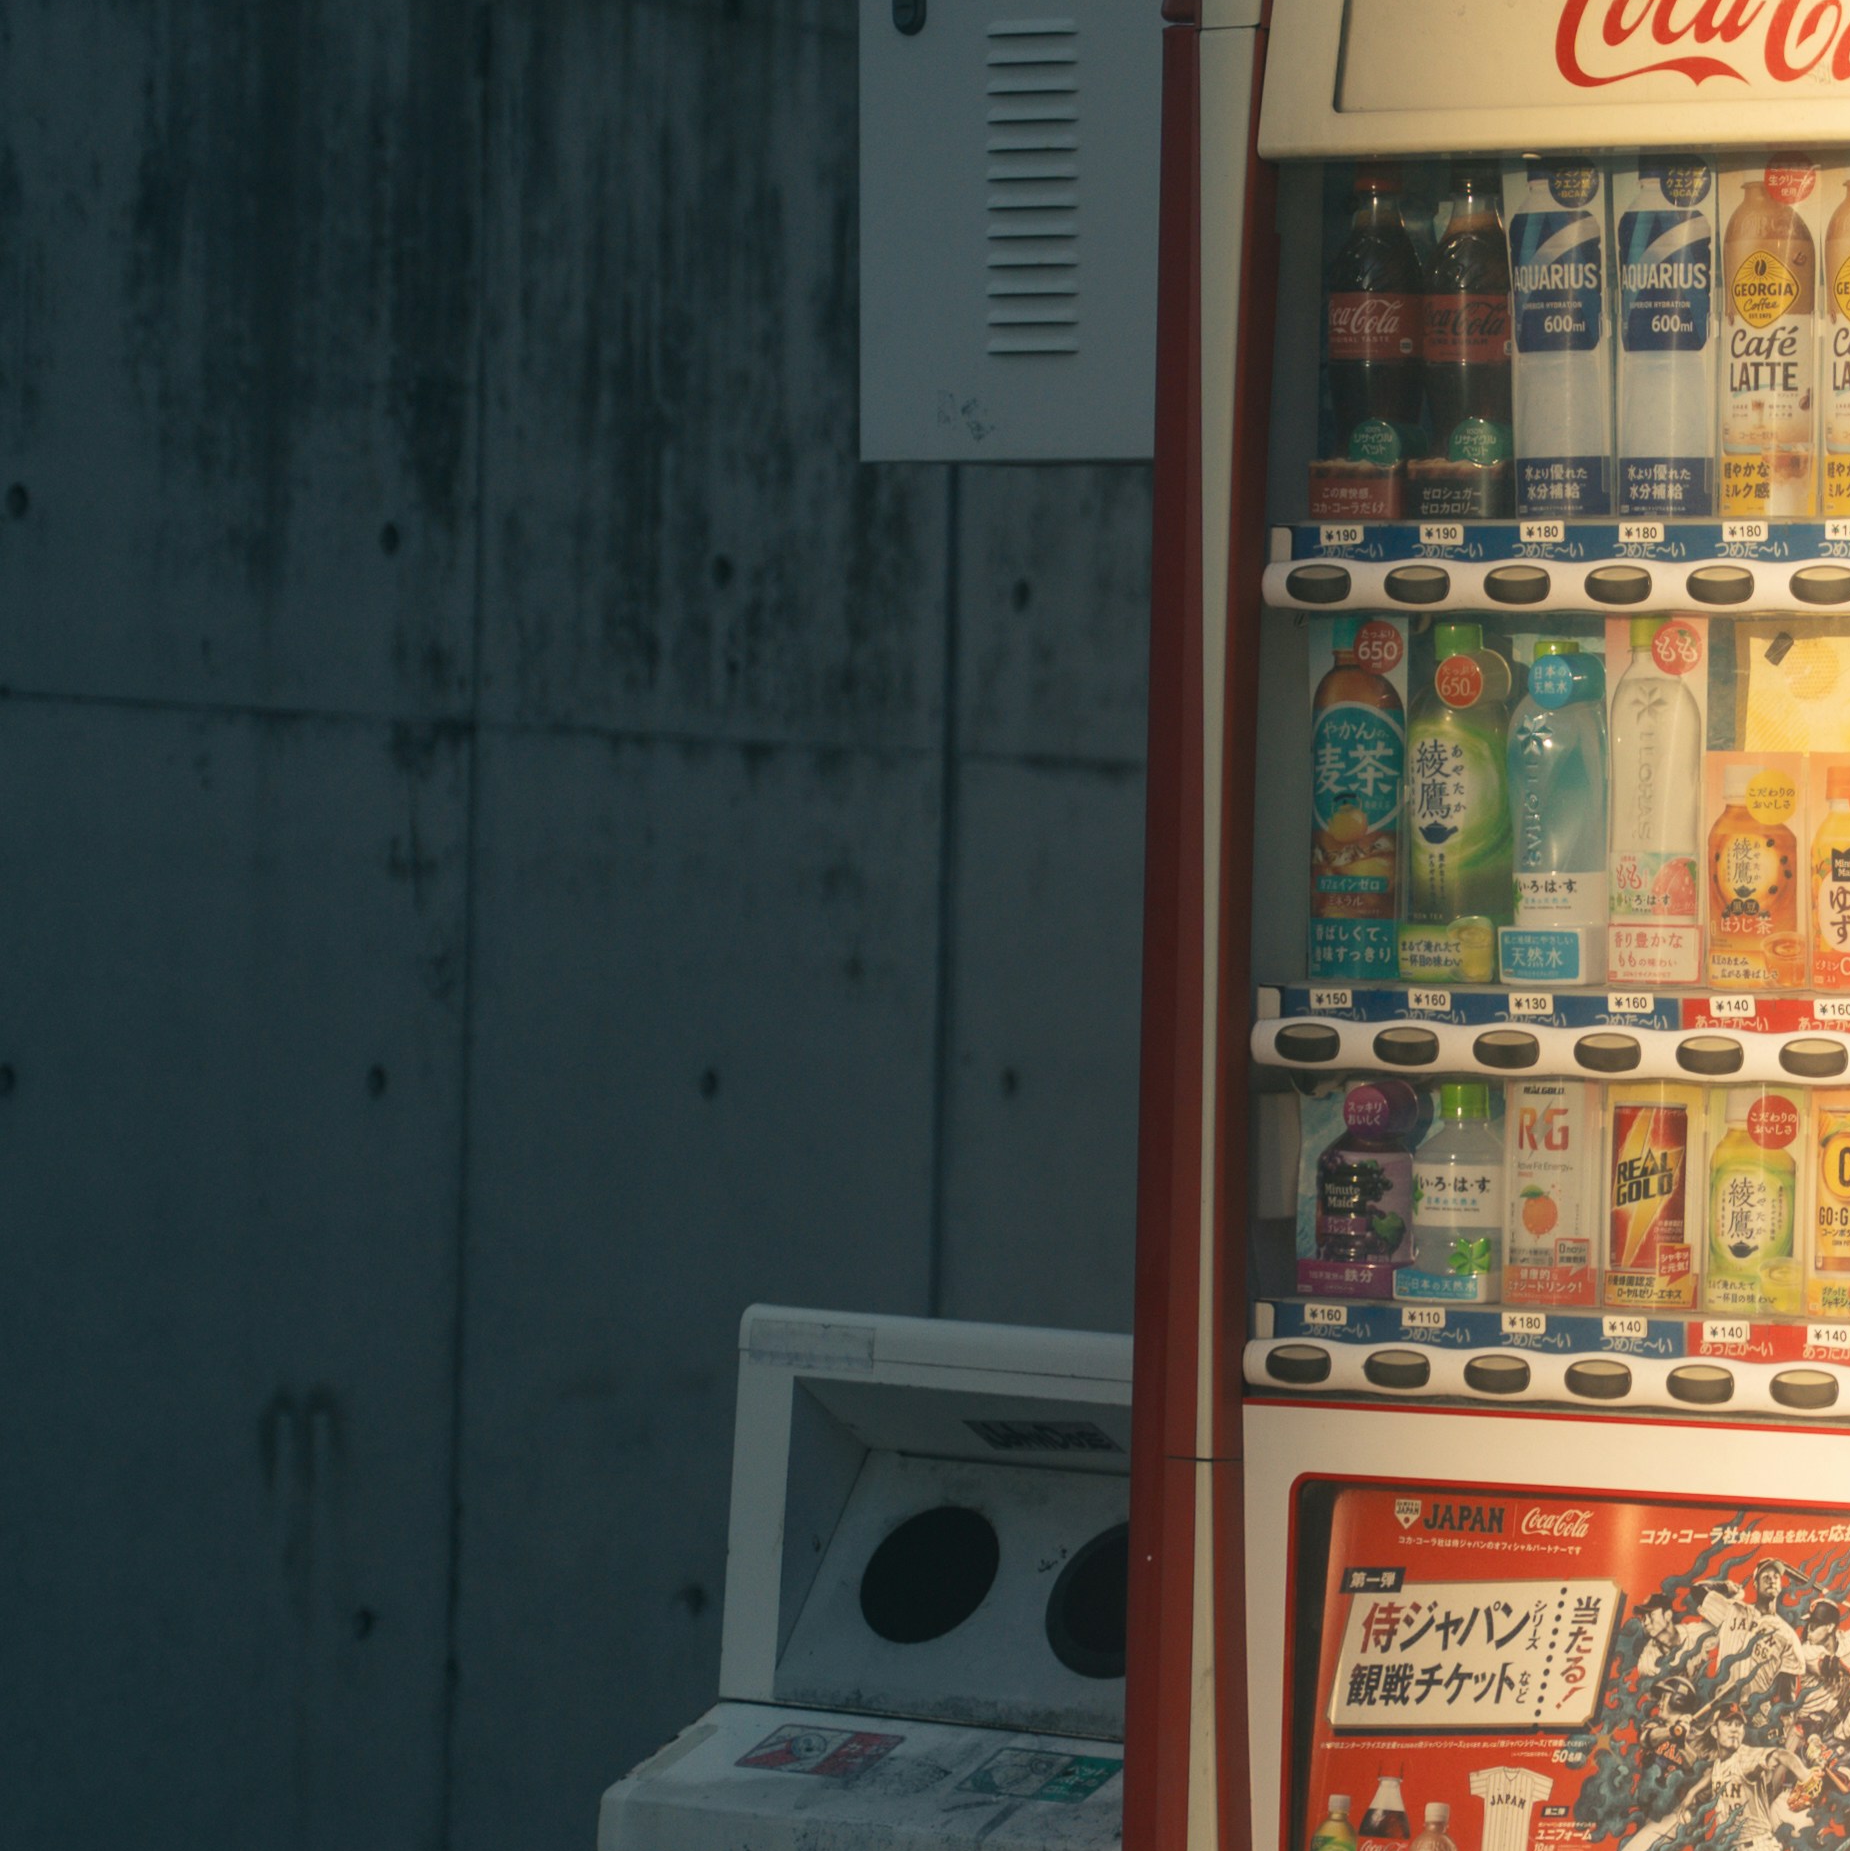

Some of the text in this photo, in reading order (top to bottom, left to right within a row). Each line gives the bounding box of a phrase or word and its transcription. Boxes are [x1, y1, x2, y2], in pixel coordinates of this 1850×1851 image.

[1514, 264, 1598, 290] AQUARIUS
[1621, 264, 1708, 290] AQUARIUS
[1734, 282, 1795, 298] GEORGIA
[1544, 315, 1586, 333] 600ml
[1651, 315, 1694, 333] 600ml
[1731, 326, 1799, 359] Café
[1730, 363, 1799, 393] LATTE
[1525, 465, 1588, 482] 水より優れた
[1627, 465, 1692, 482] 水より優れた
[1325, 527, 1358, 544] ¥190
[1424, 526, 1458, 542] ¥190
[1526, 524, 1560, 540] ¥180
[1625, 525, 1659, 541] ¥180
[1728, 524, 1762, 540] ¥180
[1357, 642, 1397, 659] 650
[1655, 635, 1698, 663] もも
[1315, 748, 1398, 796] 麦茶
[1416, 739, 1452, 819] 綾鷹
[1613, 931, 1683, 950] 香り豊かな
[1511, 947, 1566, 968] 天然水
[1315, 992, 1348, 1006] ¥150
[1413, 992, 1446, 1007] ¥160
[1514, 996, 1547, 1011] ¥130
[1614, 995, 1648, 1010] ¥160
[1715, 1000, 1749, 1013] ¥140
[1616, 1173, 1673, 1207] GOLD
[1728, 1177, 1754, 1240] 綾鷹
[1309, 1308, 1341, 1321] ¥160
[1407, 1311, 1439, 1324] ¥110
[1508, 1317, 1541, 1330] ¥180
[1608, 1321, 1641, 1333] ¥140
[1709, 1326, 1742, 1338] ¥140
[1813, 1330, 1847, 1342] ¥140
[1423, 1504, 1594, 1538] JAPAN Coca-Cola
[1349, 1572, 1396, 1588] 第一弾
[1360, 1596, 1602, 1709] 侍ジャパン シリーズ 当たる!
[1346, 1662, 1531, 1706] 観戦チケット など
[1535, 1829, 1593, 1841] ユニフォーム
